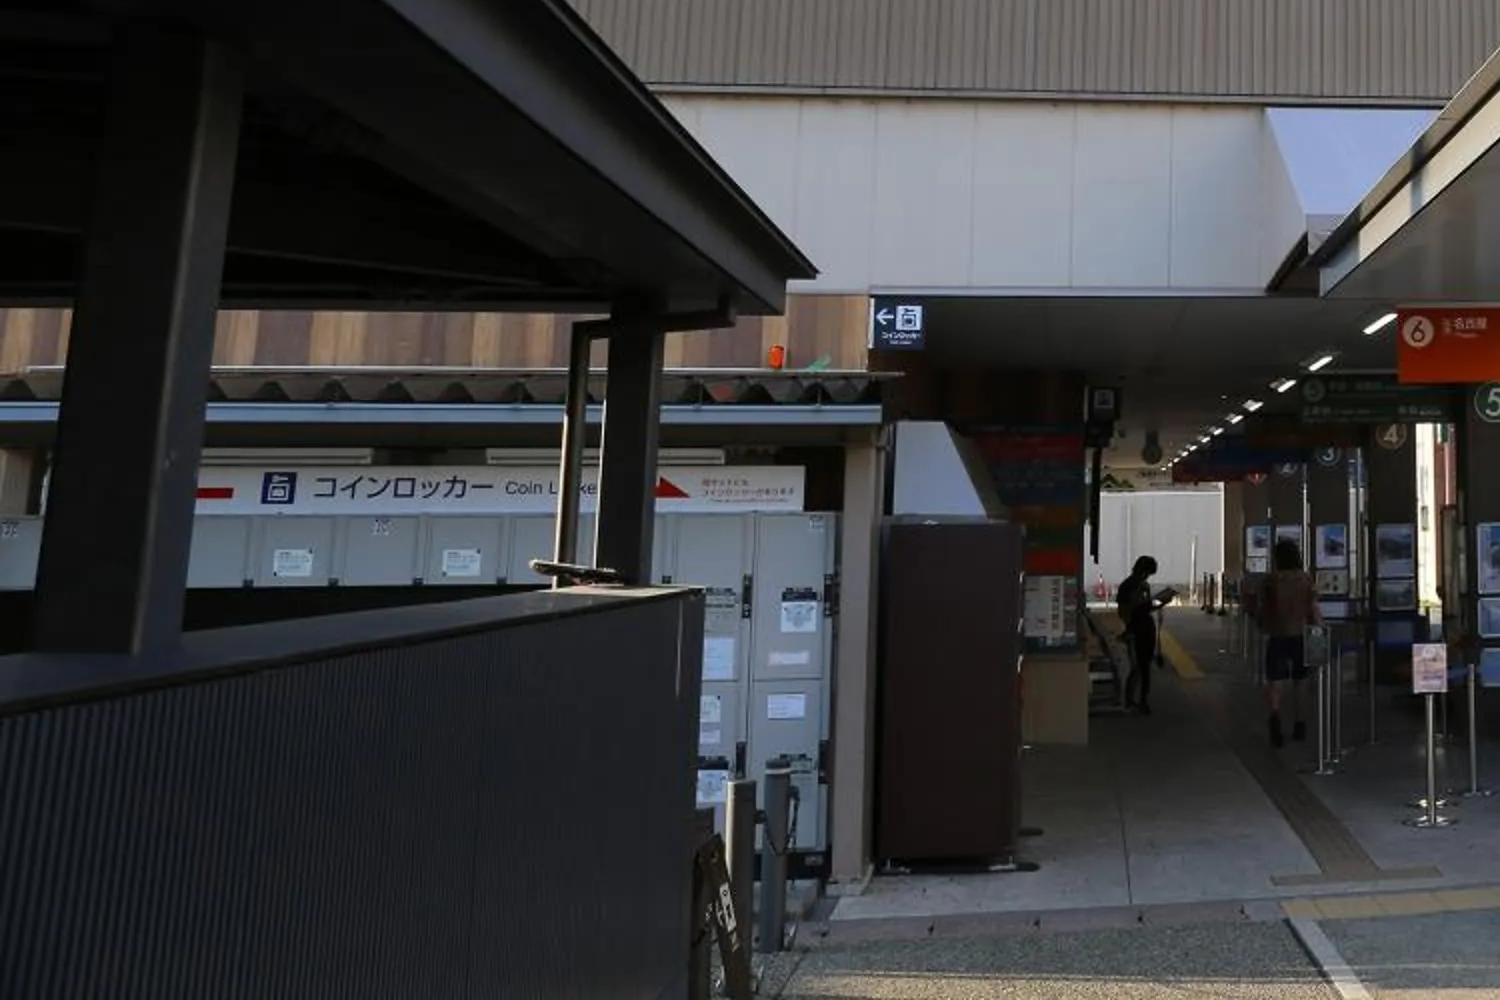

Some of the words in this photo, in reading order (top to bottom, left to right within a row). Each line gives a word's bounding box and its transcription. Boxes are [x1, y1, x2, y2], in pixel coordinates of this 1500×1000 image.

[1411, 319, 1428, 343] 6
[313, 474, 494, 500] コインロッカー
[505, 480, 543, 495] Coin
[549, 480, 598, 495] Lke
